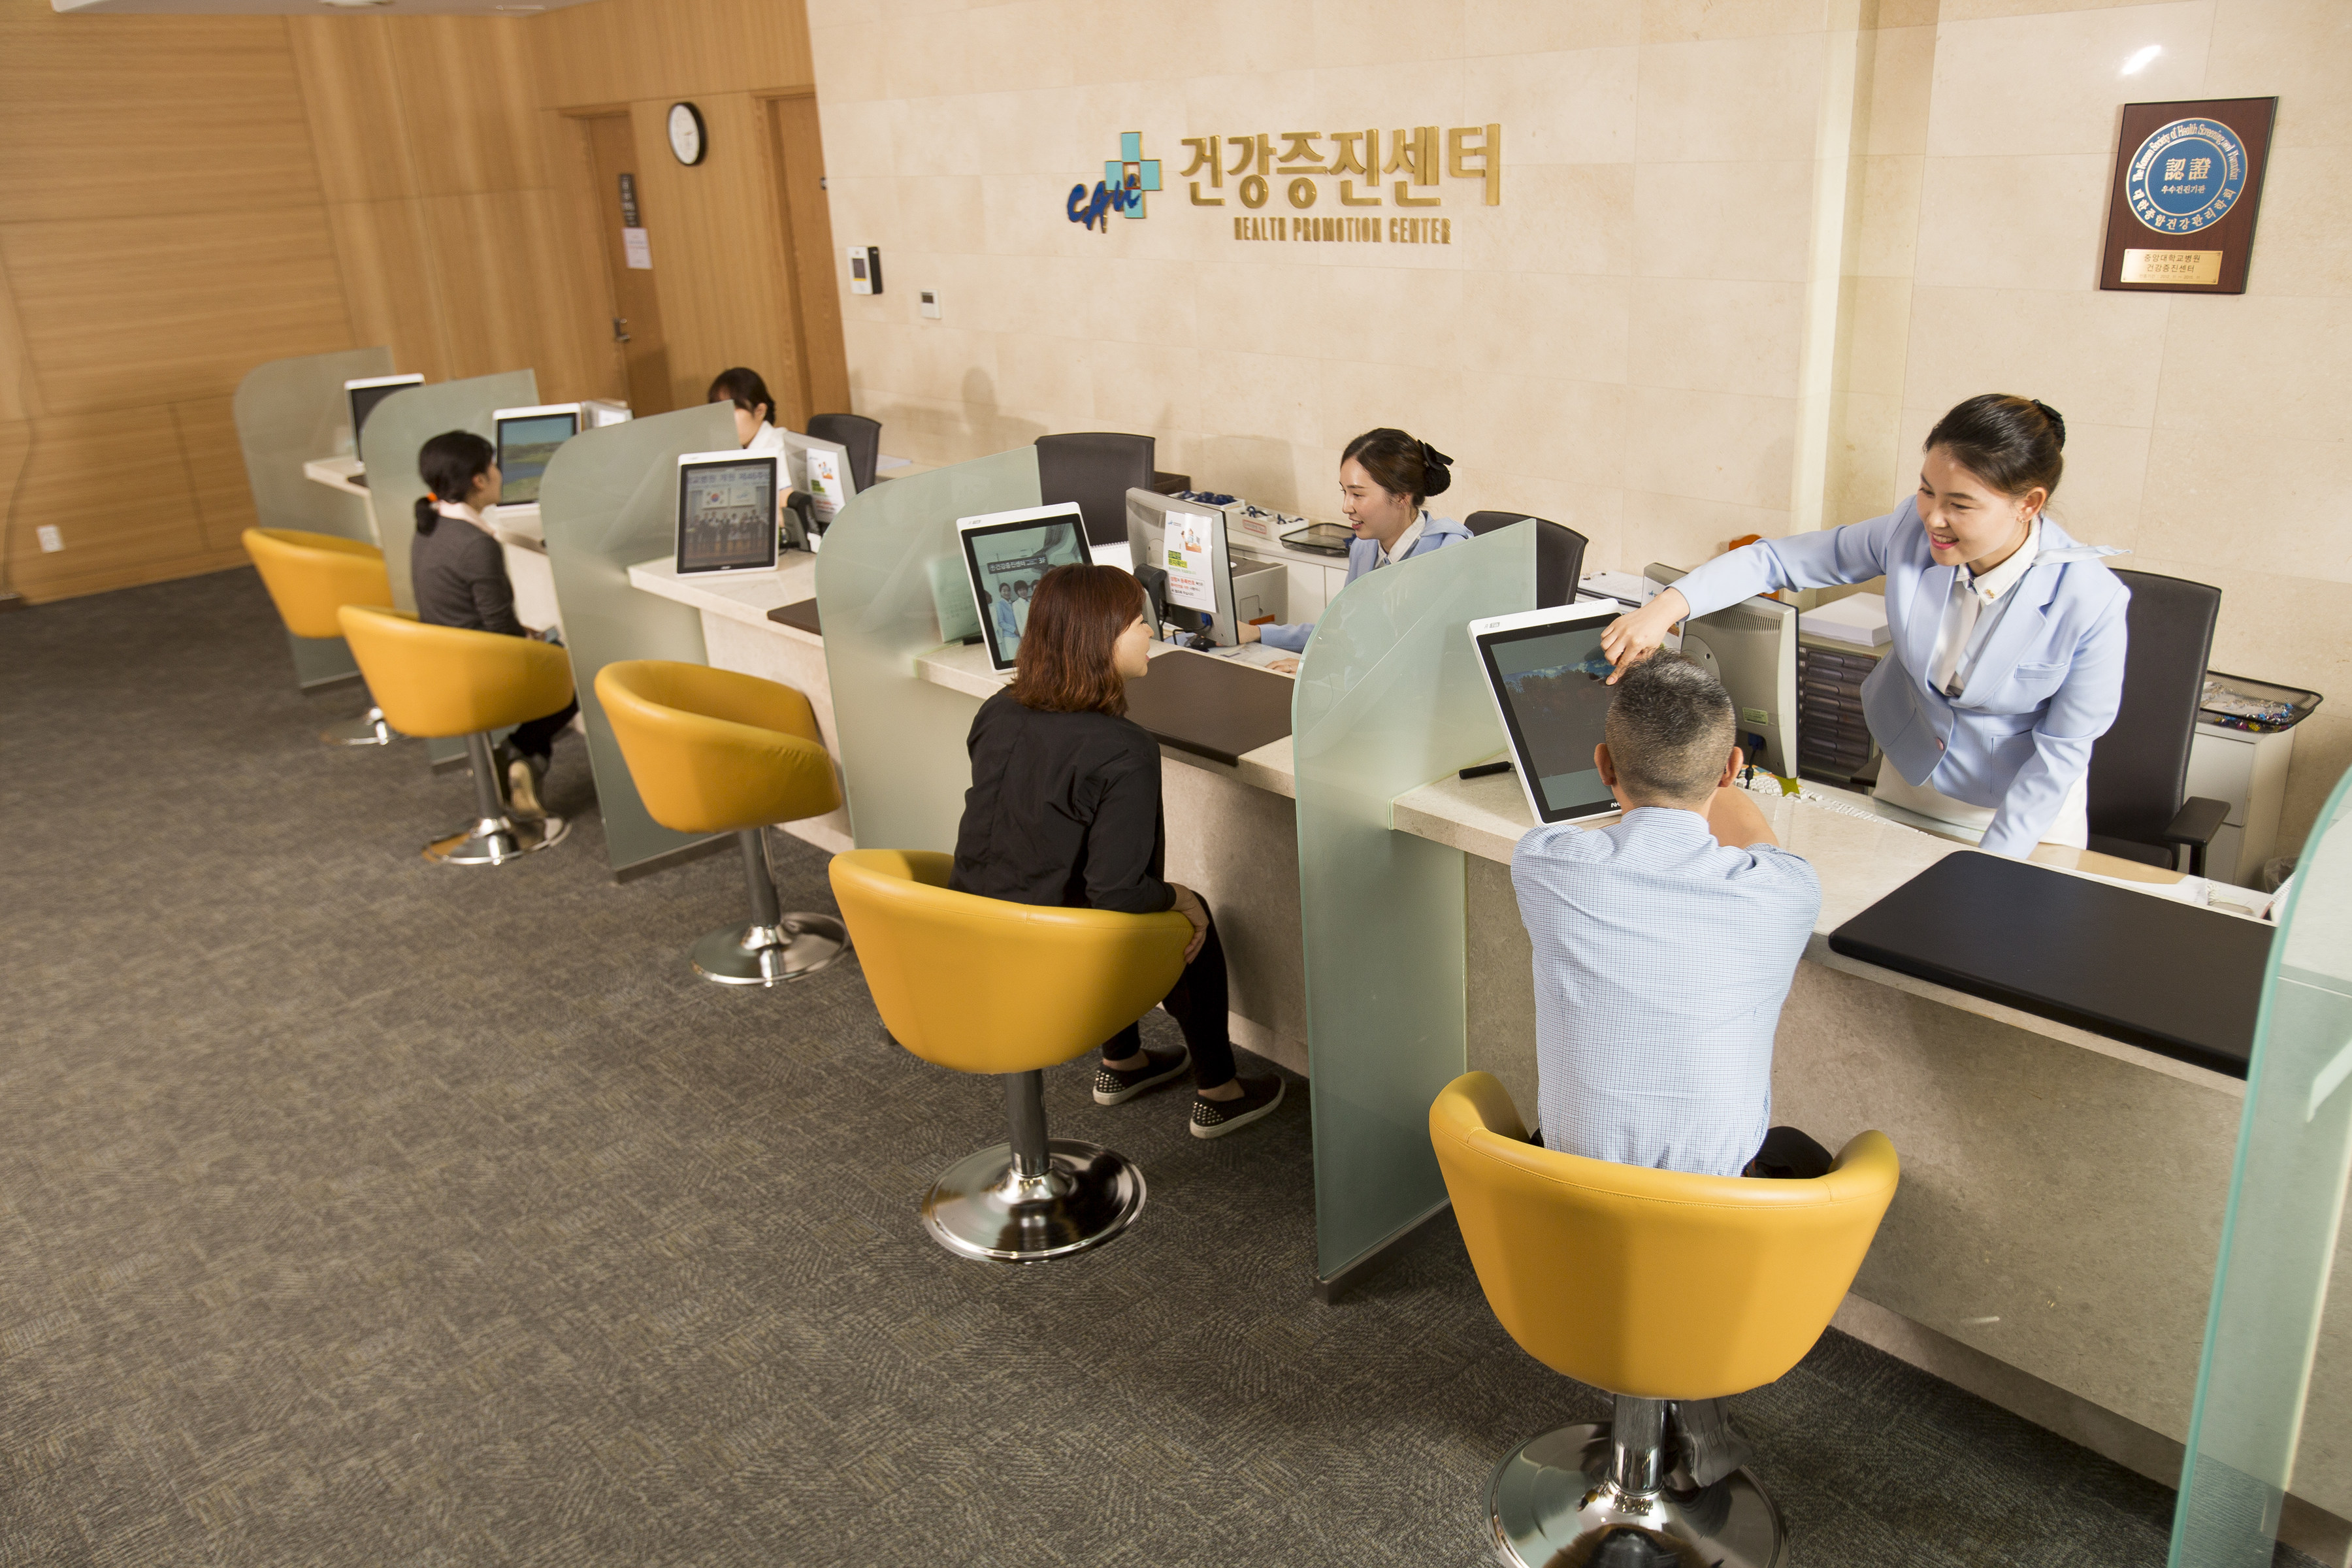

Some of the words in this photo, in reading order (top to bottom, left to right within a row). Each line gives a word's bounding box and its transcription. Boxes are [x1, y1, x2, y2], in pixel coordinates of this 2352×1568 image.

[2177, 123, 2198, 137] Health
[2149, 133, 2170, 152] Society
[2221, 139, 2236, 152] and
[2135, 148, 2155, 170] Korean
[1180, 123, 1501, 210] 건강증진센터
[2132, 169, 2145, 182] The
[2132, 188, 2237, 231] 대한종합건강관리학회
[1233, 216, 1287, 241] HEALTH
[1293, 217, 1382, 242] PROMOTION
[1389, 217, 1452, 244] CENTER
[2144, 253, 2201, 263] 중앙대학교병원
[2147, 264, 2195, 272] 건강증진센터
[995, 560, 1026, 570] 건강증진센터
